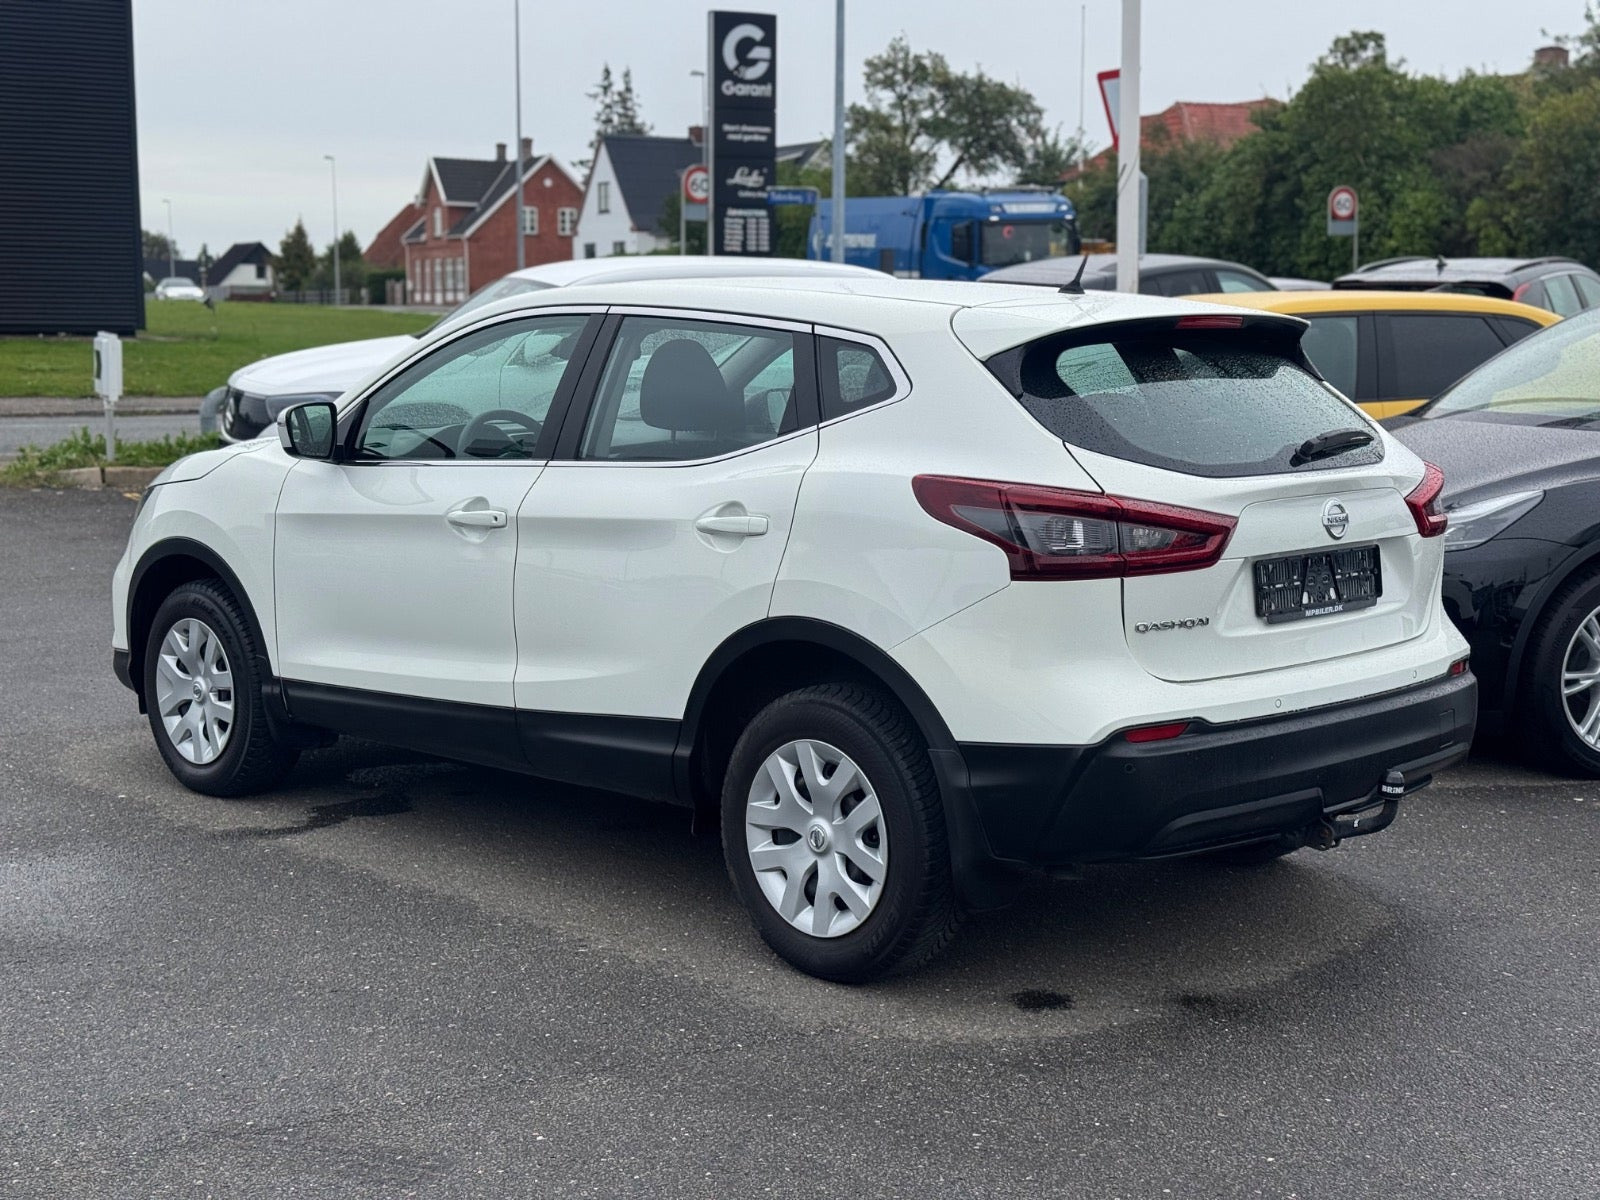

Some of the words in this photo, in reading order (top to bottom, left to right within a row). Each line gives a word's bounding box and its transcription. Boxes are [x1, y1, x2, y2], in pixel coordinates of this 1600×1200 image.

[721, 80, 772, 97] Garant
[1336, 197, 1351, 211] 60
[1135, 617, 1210, 634] QASHQAI
